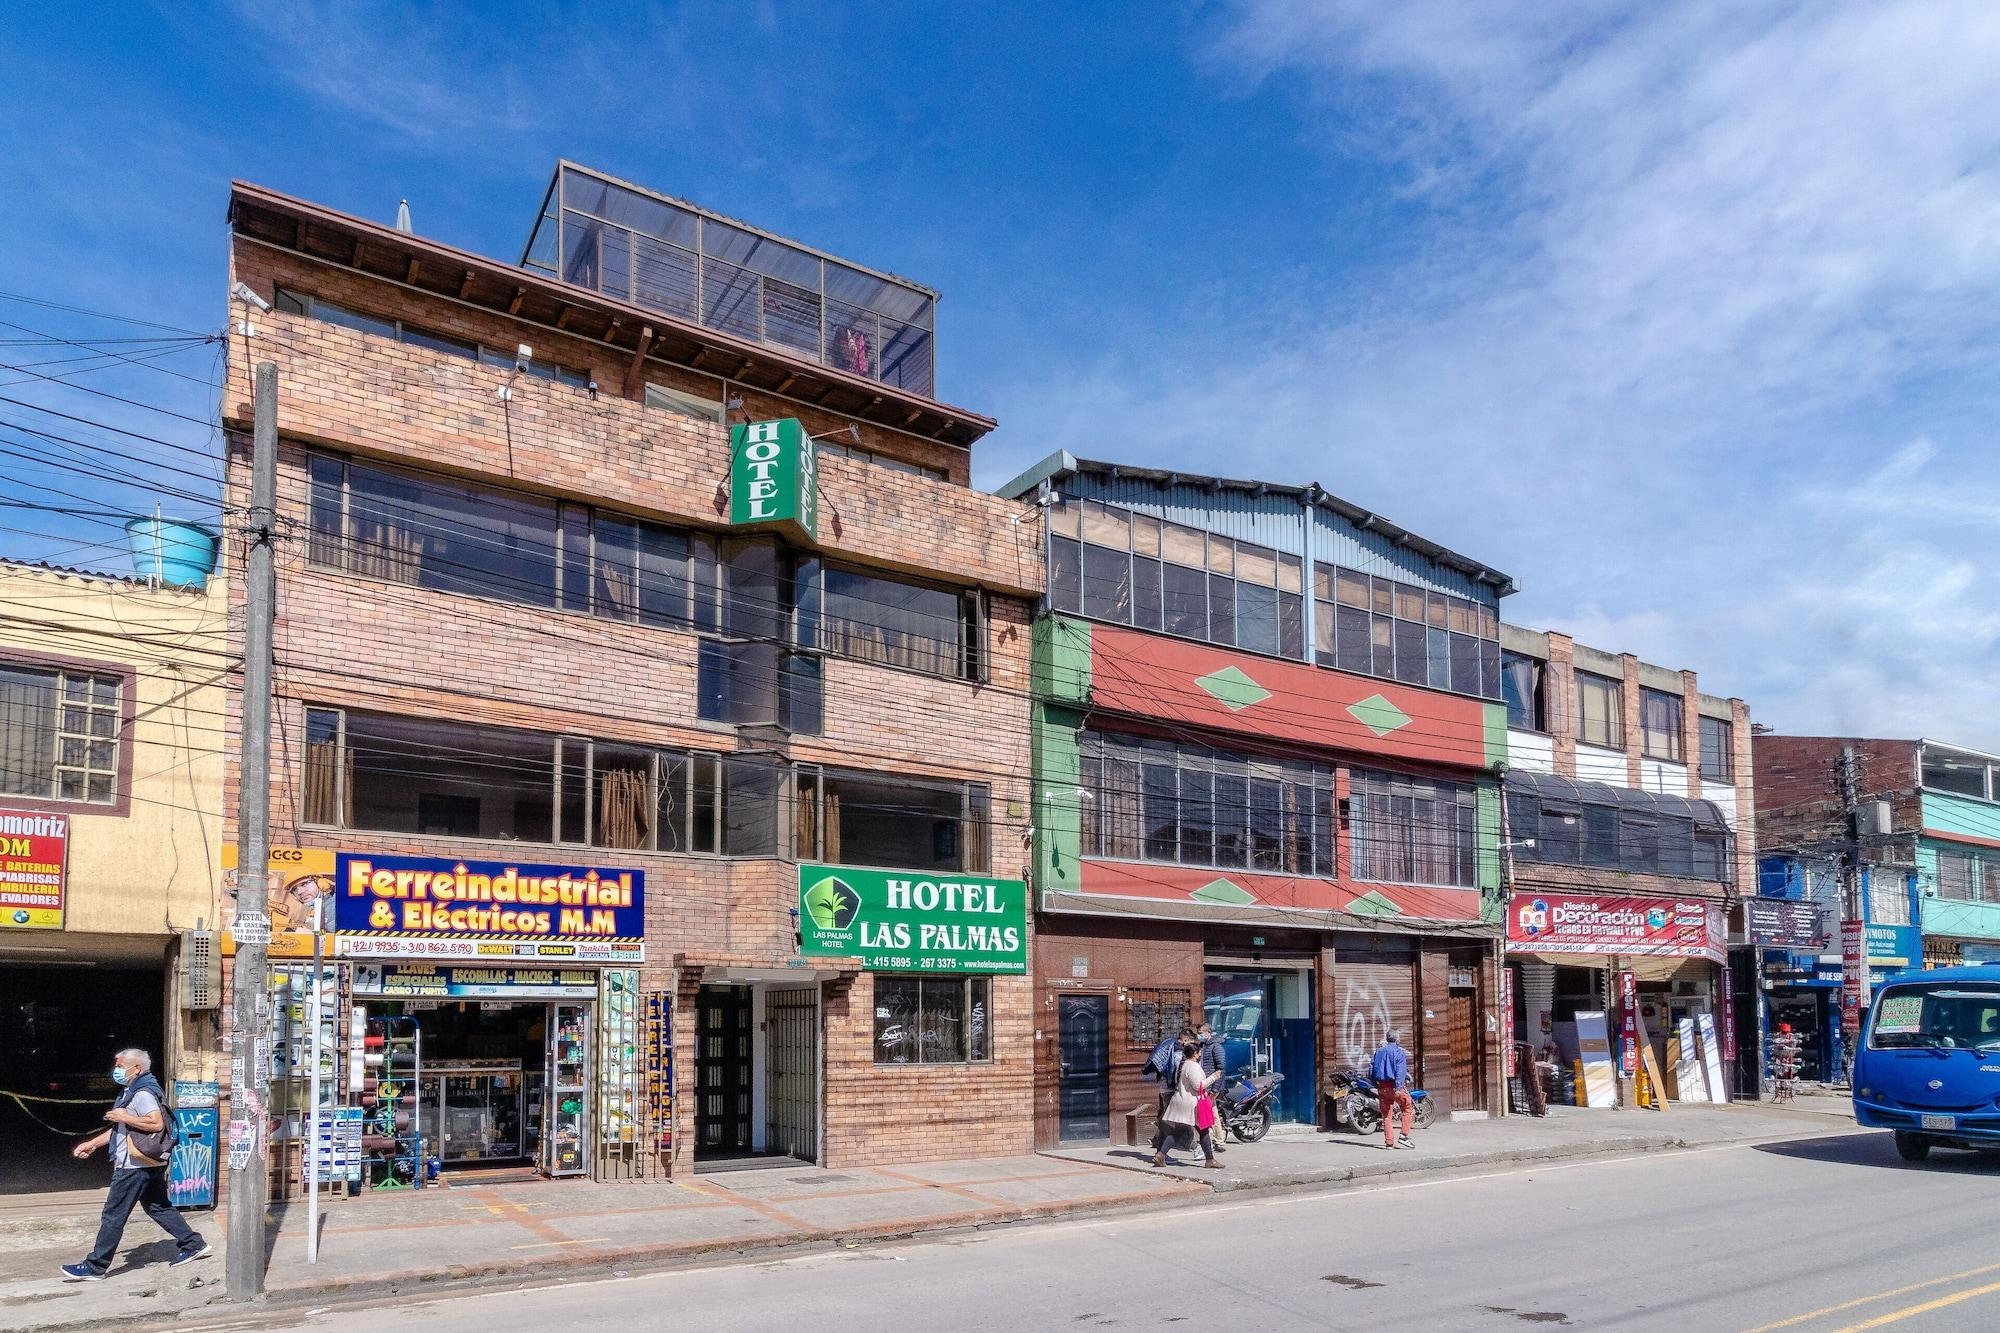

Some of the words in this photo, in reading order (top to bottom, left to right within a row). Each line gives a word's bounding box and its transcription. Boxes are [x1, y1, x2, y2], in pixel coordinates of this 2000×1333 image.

[745, 421, 781, 519] HOTEL
[800, 427, 814, 531] HOTEL
[0, 815, 65, 838] motriz
[6, 861, 60, 874] BATERIAS
[348, 860, 633, 906] Ferreindustrial
[886, 879, 1005, 913] HOTEL
[1563, 902, 1590, 911] Diseño
[1592, 903, 1599, 911] &
[369, 900, 396, 929] &
[403, 901, 551, 933] Eléctricos
[559, 907, 616, 936] M.M
[1553, 907, 1644, 925] Decoración
[813, 930, 825, 939] LAS
[826, 932, 853, 940] PALMAS
[859, 921, 911, 949] LAS
[919, 923, 1019, 952] PALMAS
[1554, 924, 1581, 934] TECHOS
[1583, 926, 1592, 935] EN
[352, 941, 372, 952] 421
[374, 941, 399, 953] 9935
[407, 943, 426, 953] 310
[427, 943, 447, 953] 862
[450, 943, 474, 955] 5190
[540, 946, 574, 955] STANLEY
[873, 956, 890, 967] 415
[891, 957, 911, 968] 5895
[920, 958, 935, 968] 267
[937, 958, 956, 968] 3375
[397, 965, 437, 975] LLAVES
[452, 968, 508, 983] ESCOBILLAS
[514, 971, 553, 983] MACHOS
[385, 975, 446, 986] ESPECIALES
[412, 987, 418, 995] Y
[1626, 1016, 1634, 1031] EN
